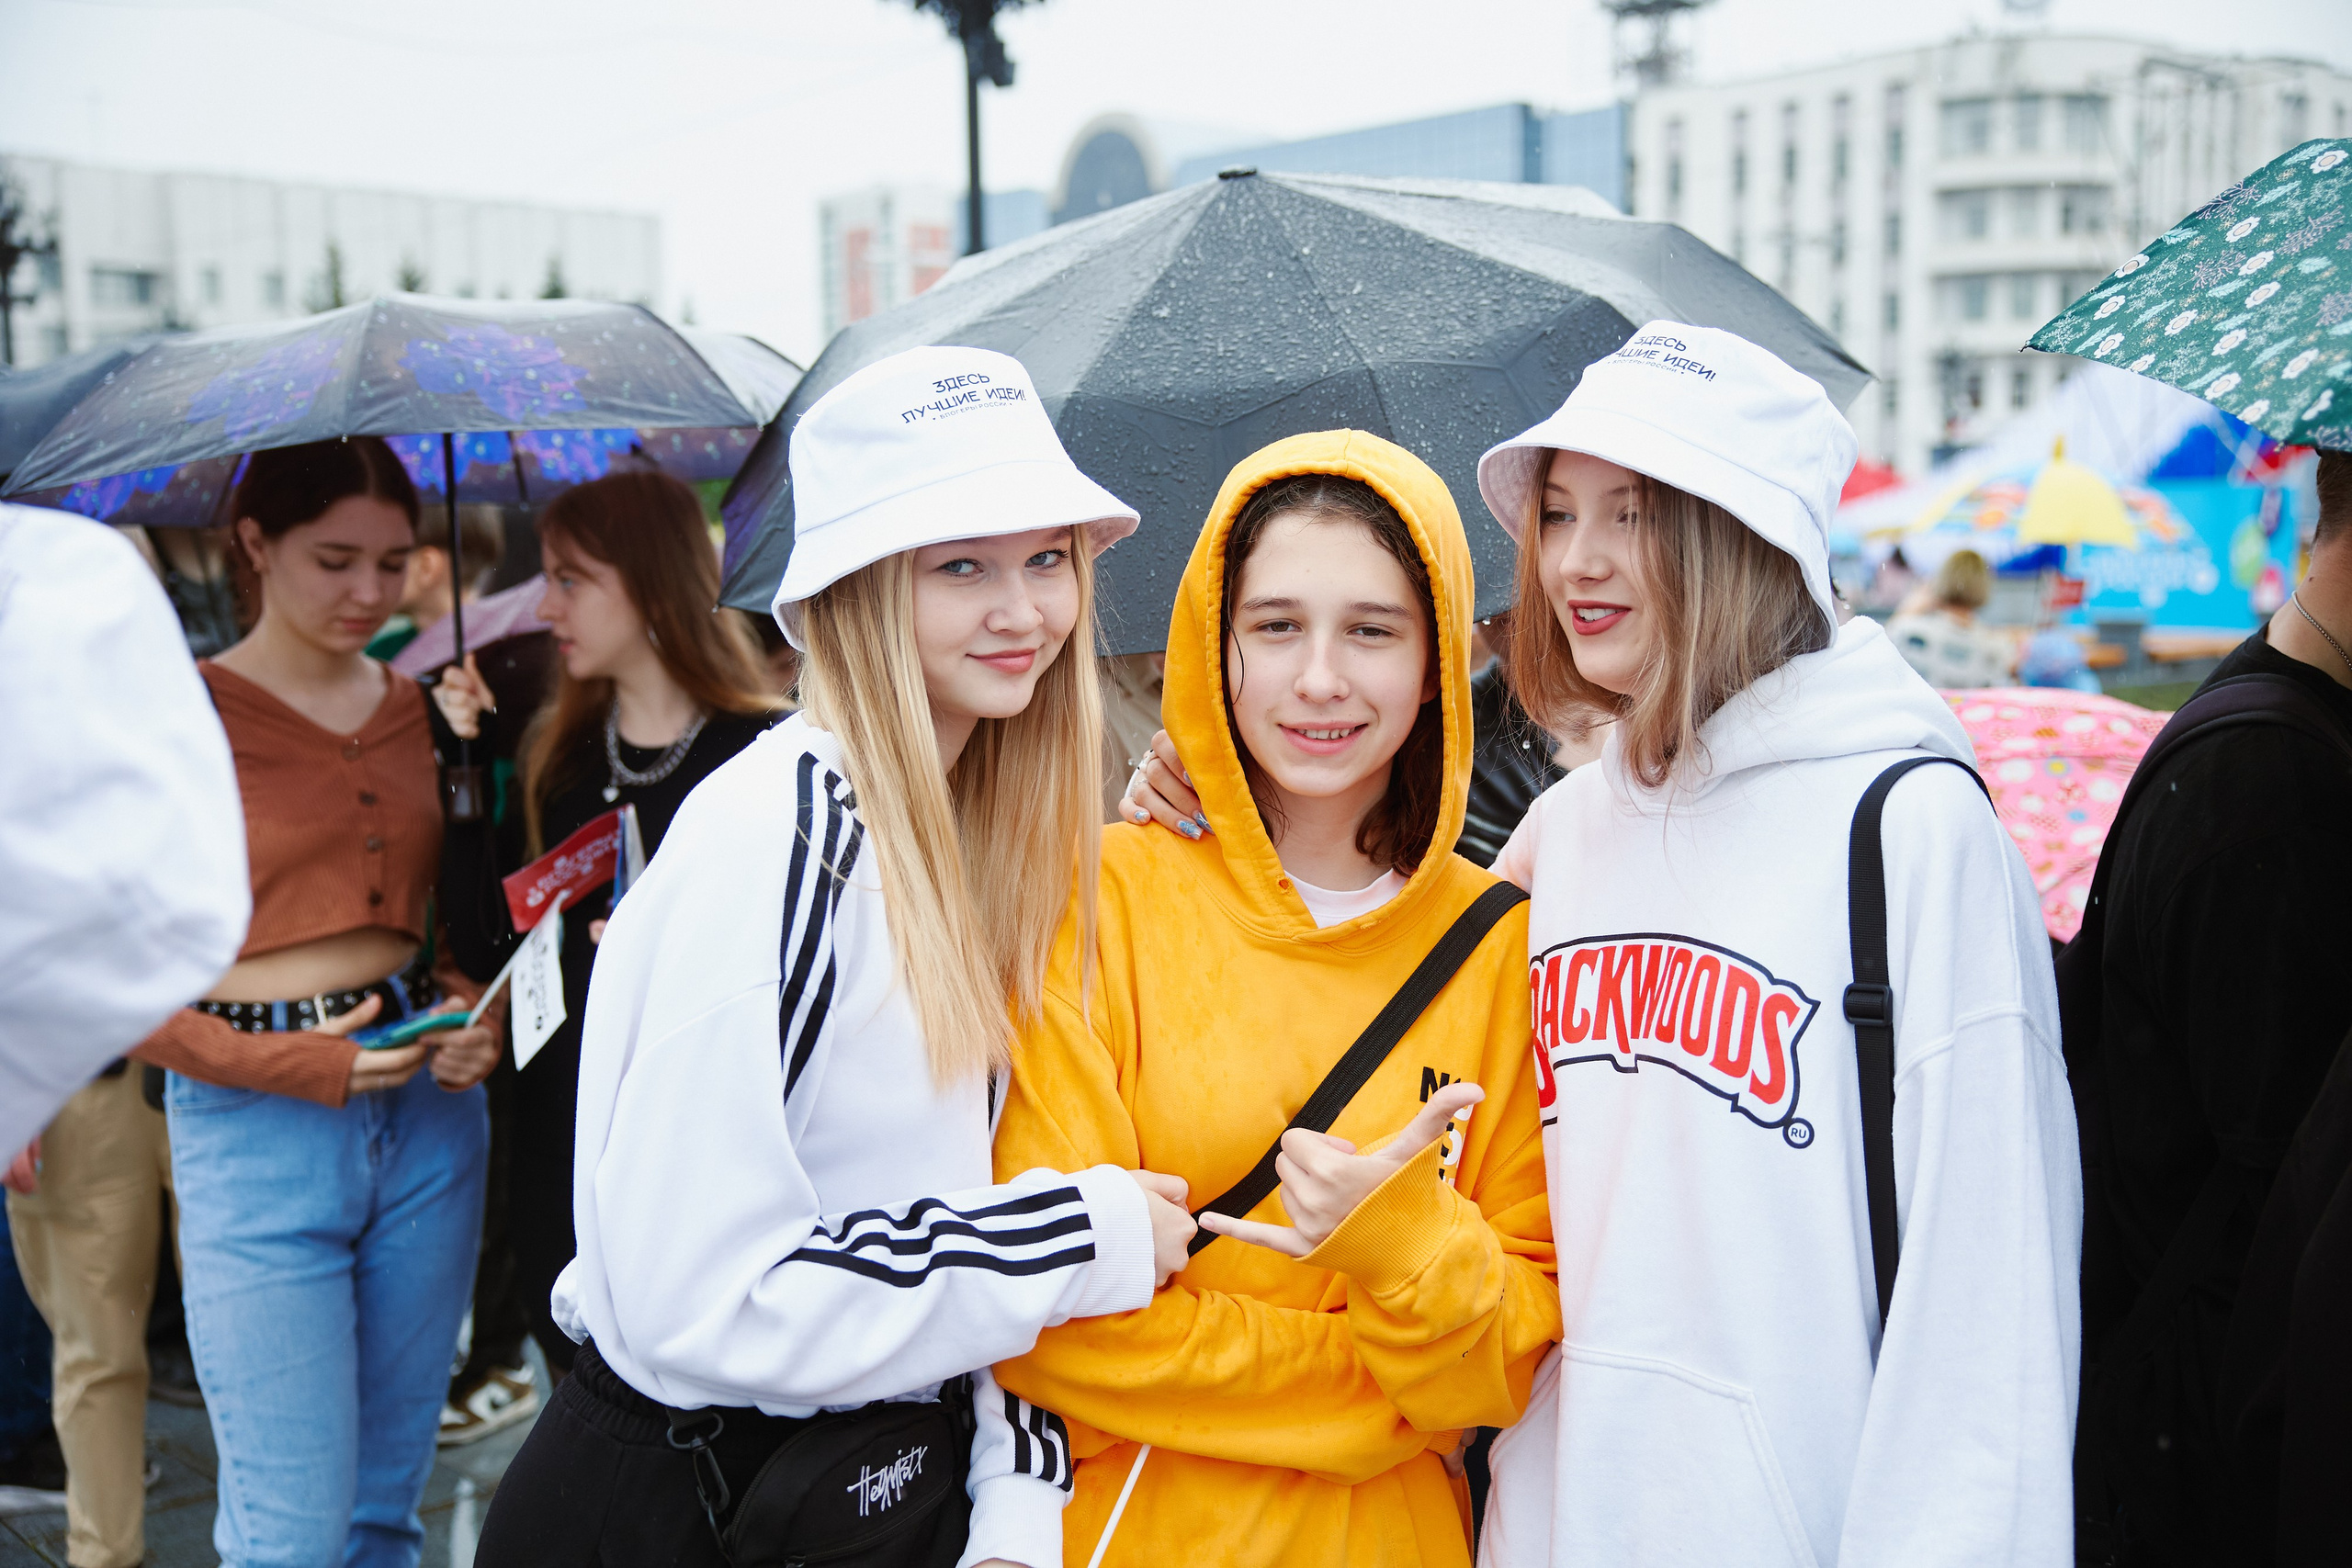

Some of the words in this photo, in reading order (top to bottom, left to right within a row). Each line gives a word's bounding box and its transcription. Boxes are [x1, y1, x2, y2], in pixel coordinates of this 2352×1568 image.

[1634, 335, 1687, 352] ЗДЕСЬ
[1615, 348, 1660, 360] ЧШИЕ
[1663, 353, 1716, 382] ИДЕИ!
[932, 373, 990, 393] ЗДЕСЬ
[900, 390, 981, 424] ЛУЧШИЕ
[985, 388, 1027, 401] ИДЕИ!
[1791, 1126, 1807, 1139] RU
